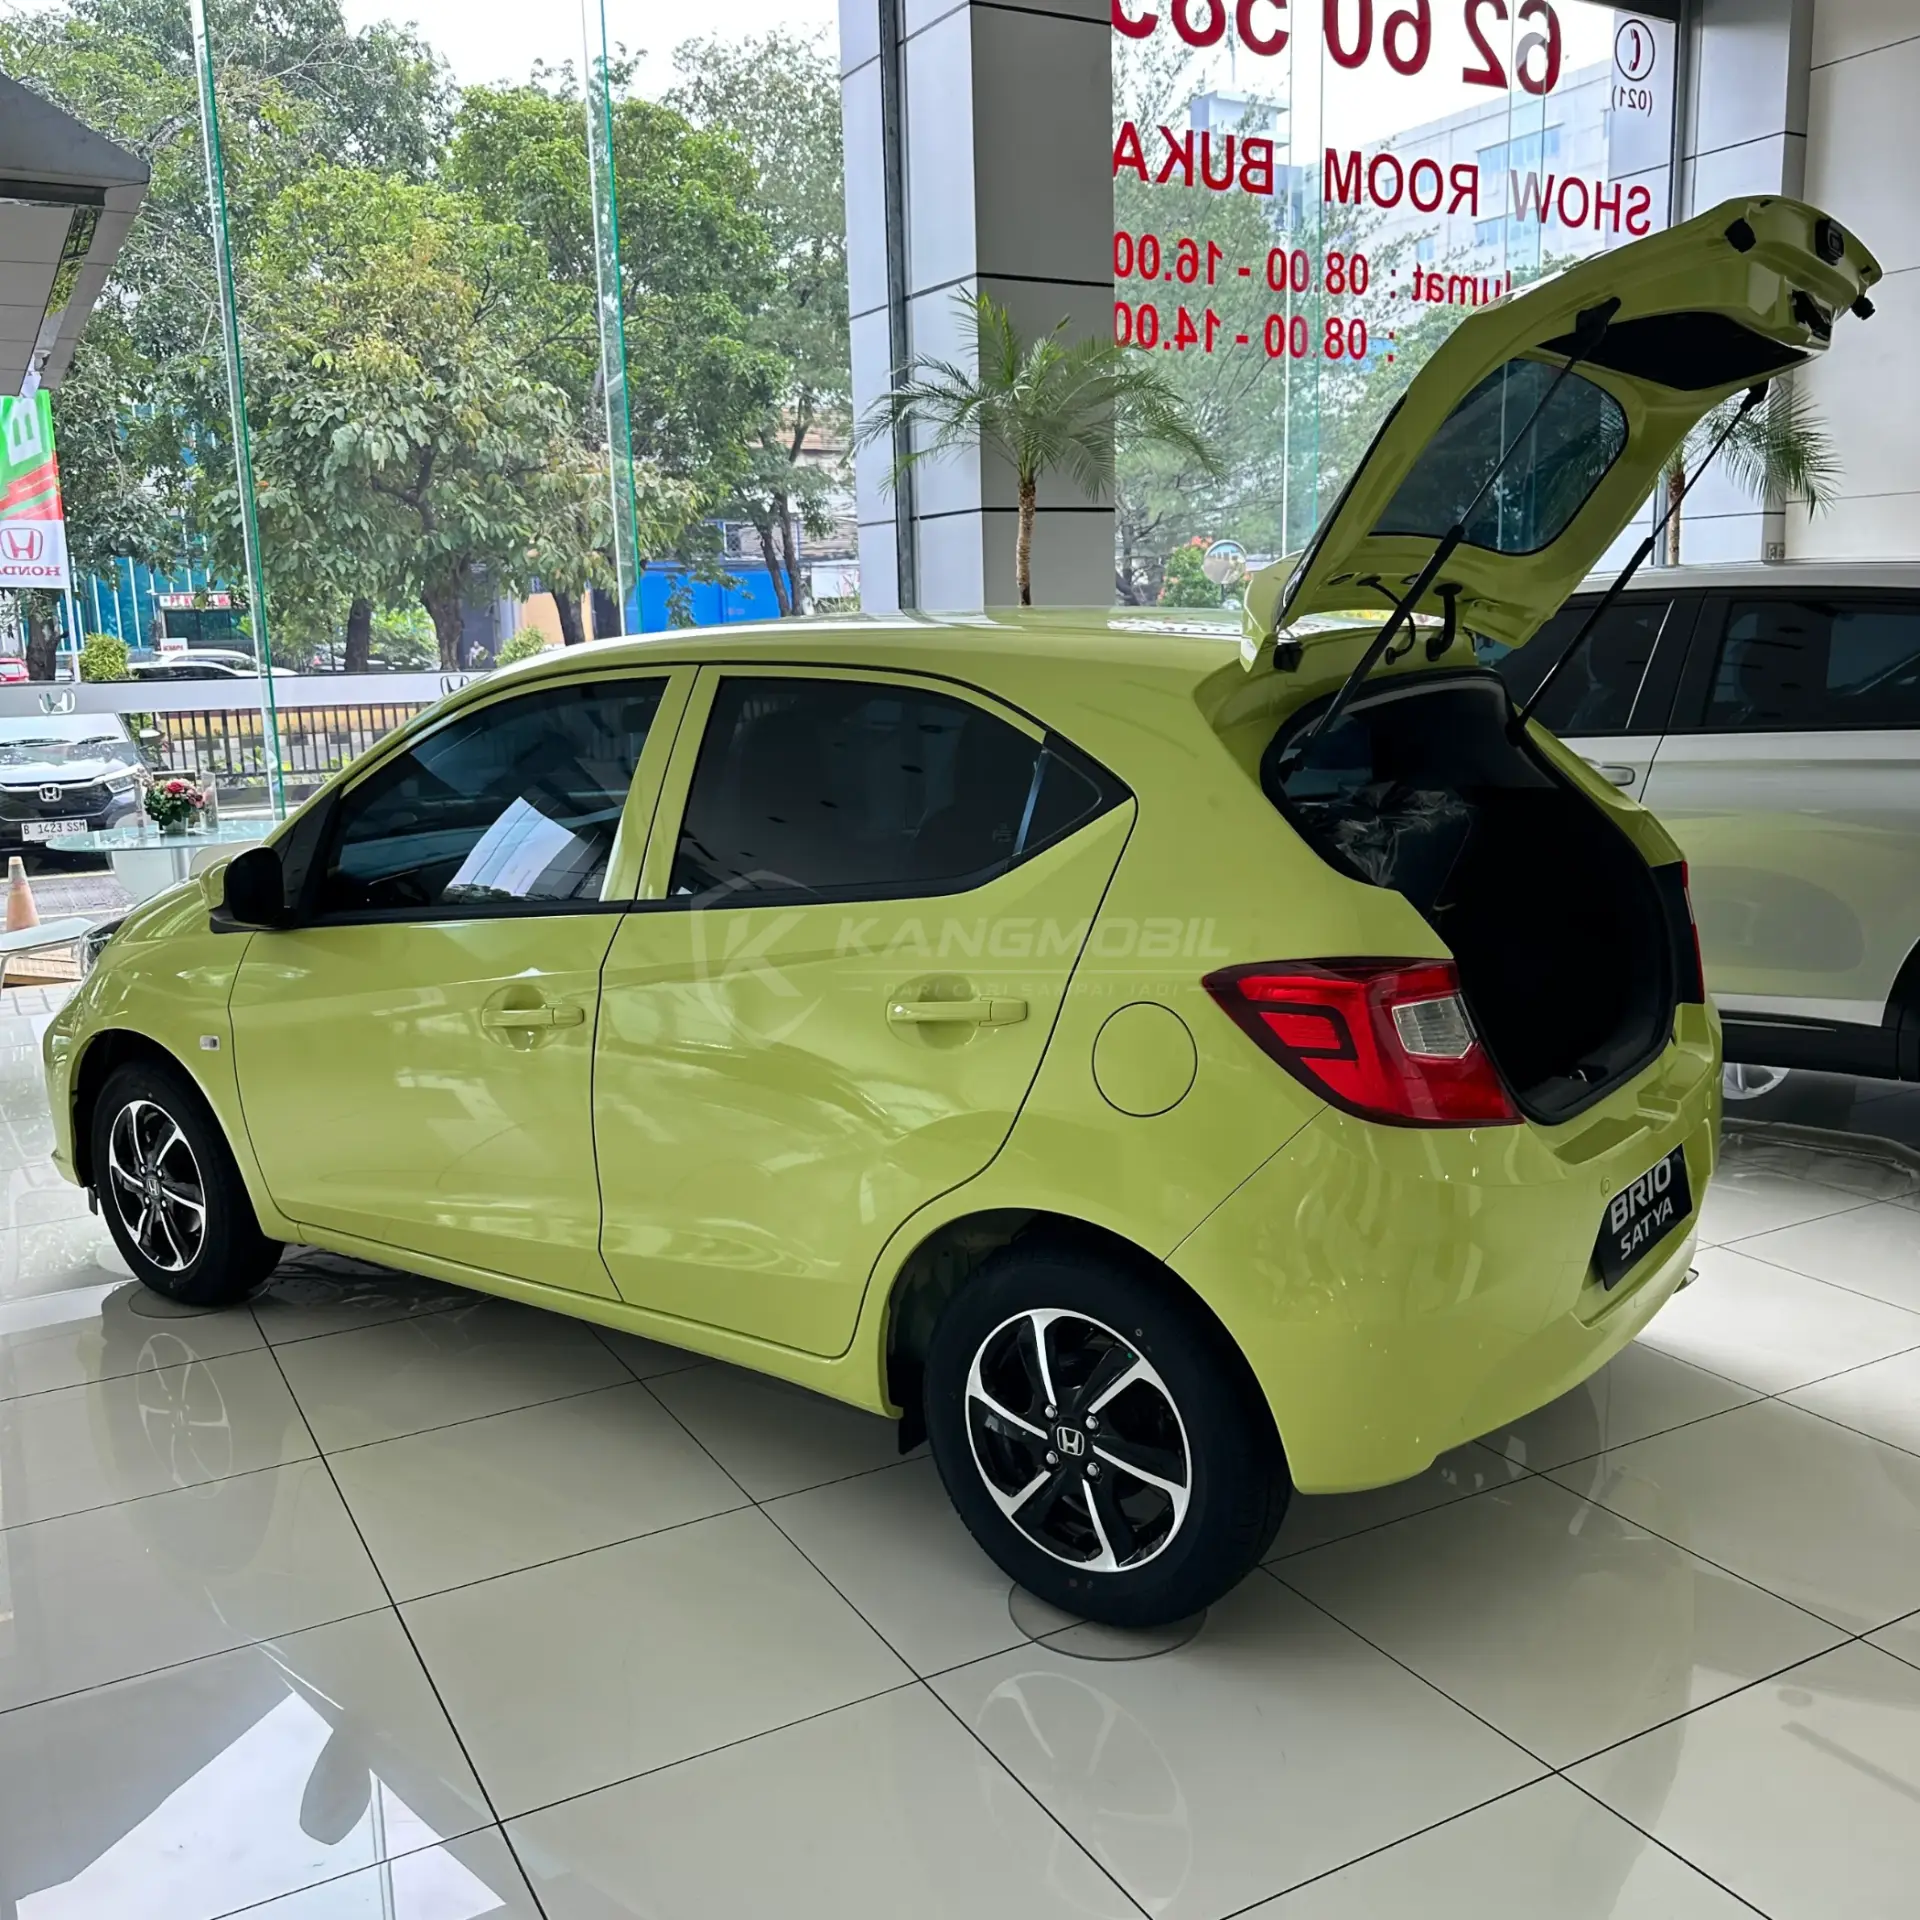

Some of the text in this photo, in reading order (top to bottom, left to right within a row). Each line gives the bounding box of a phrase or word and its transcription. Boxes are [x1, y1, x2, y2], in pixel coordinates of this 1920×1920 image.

[23, 821, 86, 835] B 1423 SSM
[1610, 1157, 1672, 1235] BRIO
[1620, 1196, 1674, 1261] SATYA
